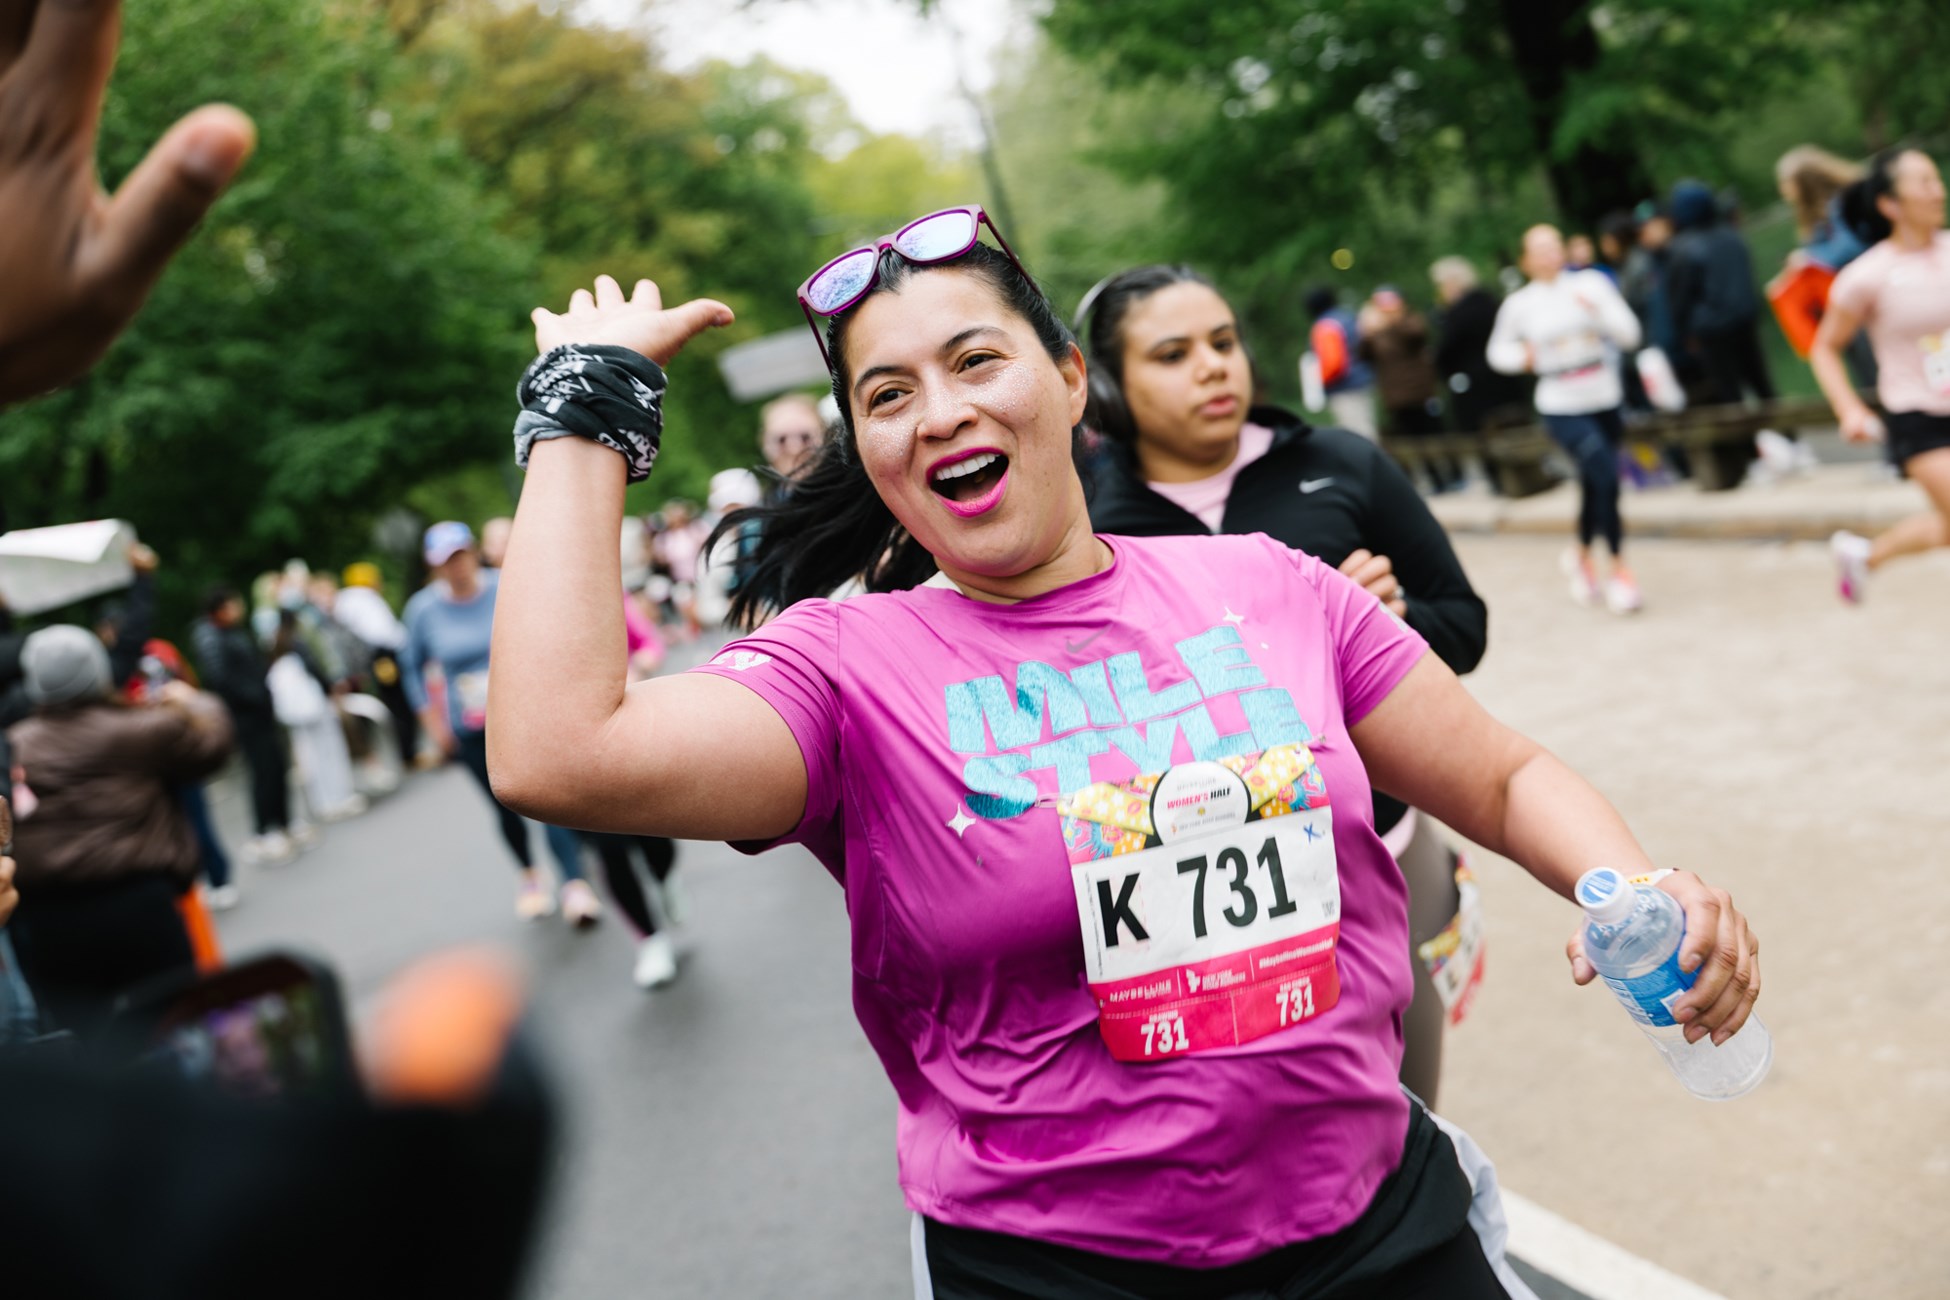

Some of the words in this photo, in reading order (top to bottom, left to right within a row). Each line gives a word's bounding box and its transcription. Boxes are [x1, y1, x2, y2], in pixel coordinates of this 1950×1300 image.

[944, 625, 1269, 754] MILE
[962, 687, 1313, 821] STYLE
[1167, 792, 1209, 810] WOMEN'S
[1096, 872, 1150, 949] K
[1176, 836, 1297, 939] 731
[1140, 1016, 1190, 1056] 731
[1275, 982, 1315, 1027] 731
